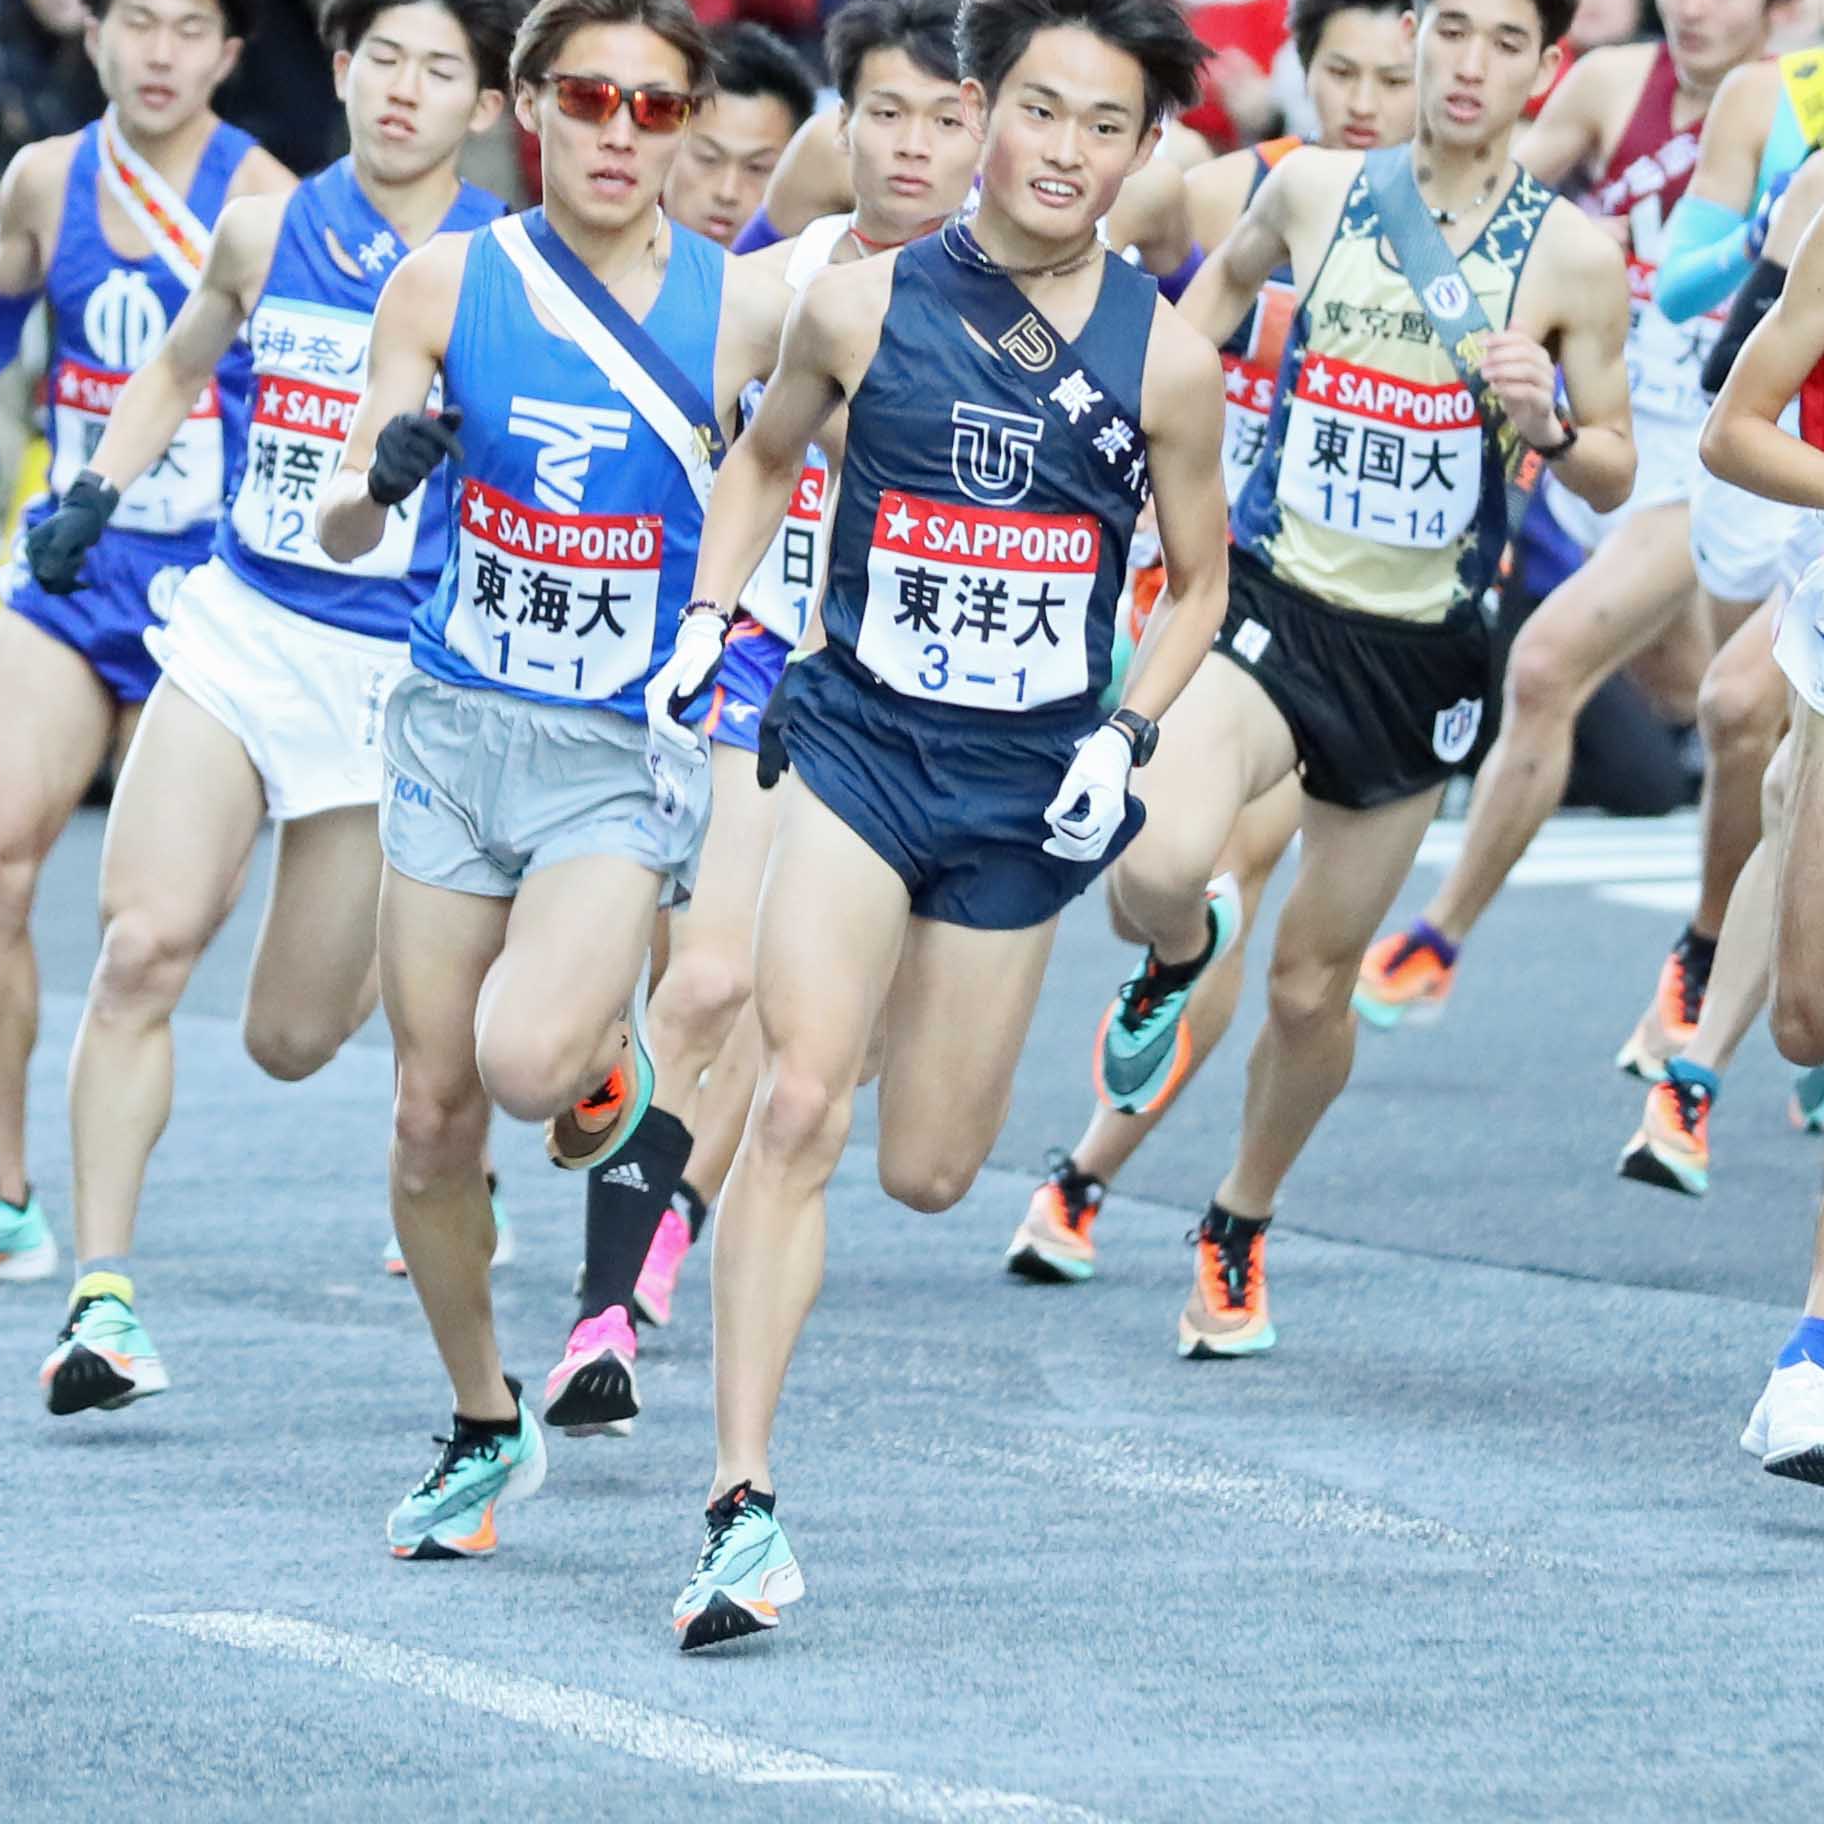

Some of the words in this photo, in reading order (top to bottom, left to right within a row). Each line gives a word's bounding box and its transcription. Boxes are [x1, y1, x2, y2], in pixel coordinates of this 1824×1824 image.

[284, 390, 356, 433] SAPP
[1336, 373, 1475, 425] SAPPORO
[1049, 369, 1152, 502] 東洋大
[1232, 416, 1269, 467] 法
[1308, 417, 1459, 494] 東国大
[497, 513, 655, 562] SAPPORO
[924, 515, 1093, 564] SAPPORO
[1318, 482, 1447, 540] 11-14
[473, 550, 632, 638] 東海大
[893, 565, 1066, 648] 東洋大
[492, 631, 586, 692] 1-1
[918, 644, 1028, 704] 3-1
